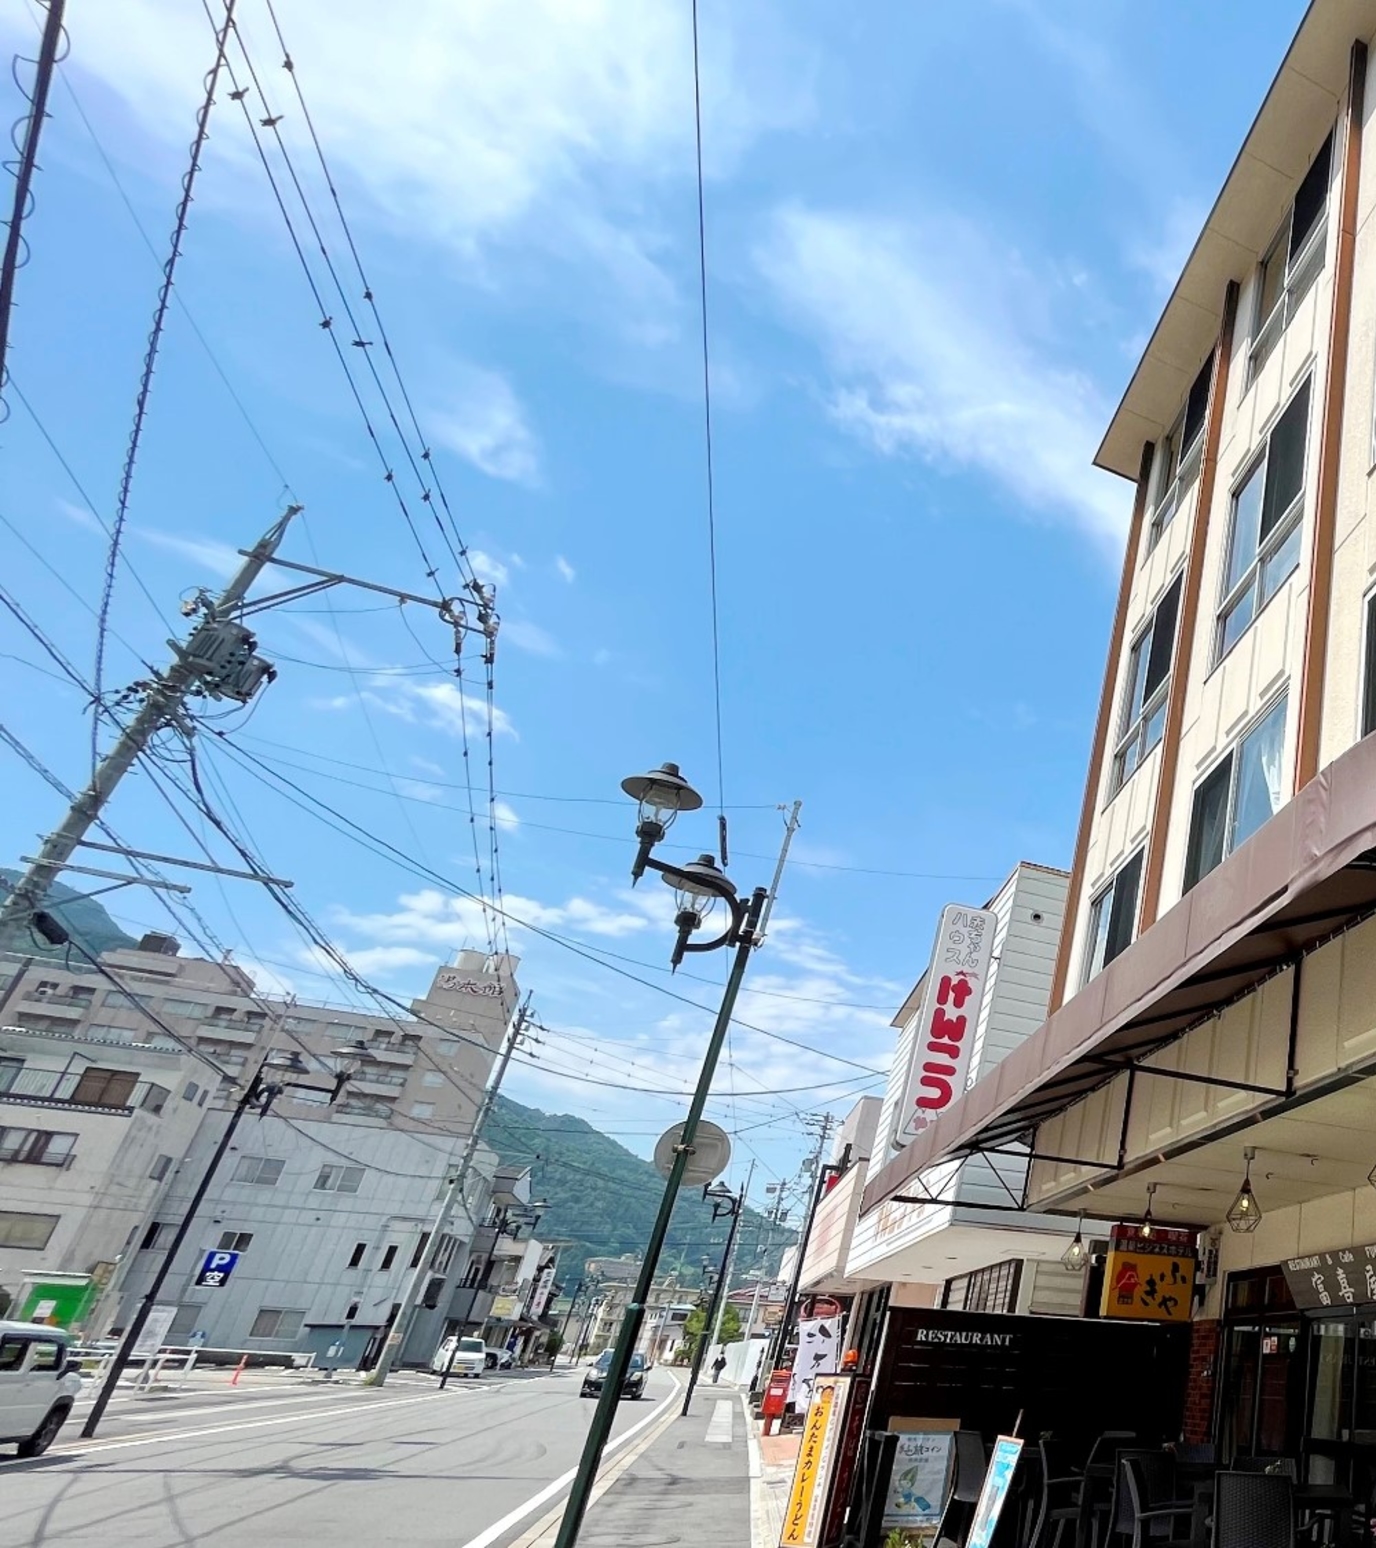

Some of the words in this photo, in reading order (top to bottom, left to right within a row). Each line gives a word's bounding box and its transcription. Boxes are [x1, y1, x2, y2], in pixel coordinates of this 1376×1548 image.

[945, 911, 968, 966] ハウス
[962, 915, 986, 969] 赤ちゃん
[201, 1271, 225, 1286] 空
[210, 1253, 231, 1269] P
[1287, 1255, 1322, 1271] RESTAURANT
[1140, 1261, 1188, 1316] ふきや
[915, 1328, 1014, 1346] RESTAURANT
[787, 1405, 824, 1541] おんたまカレーうどん
